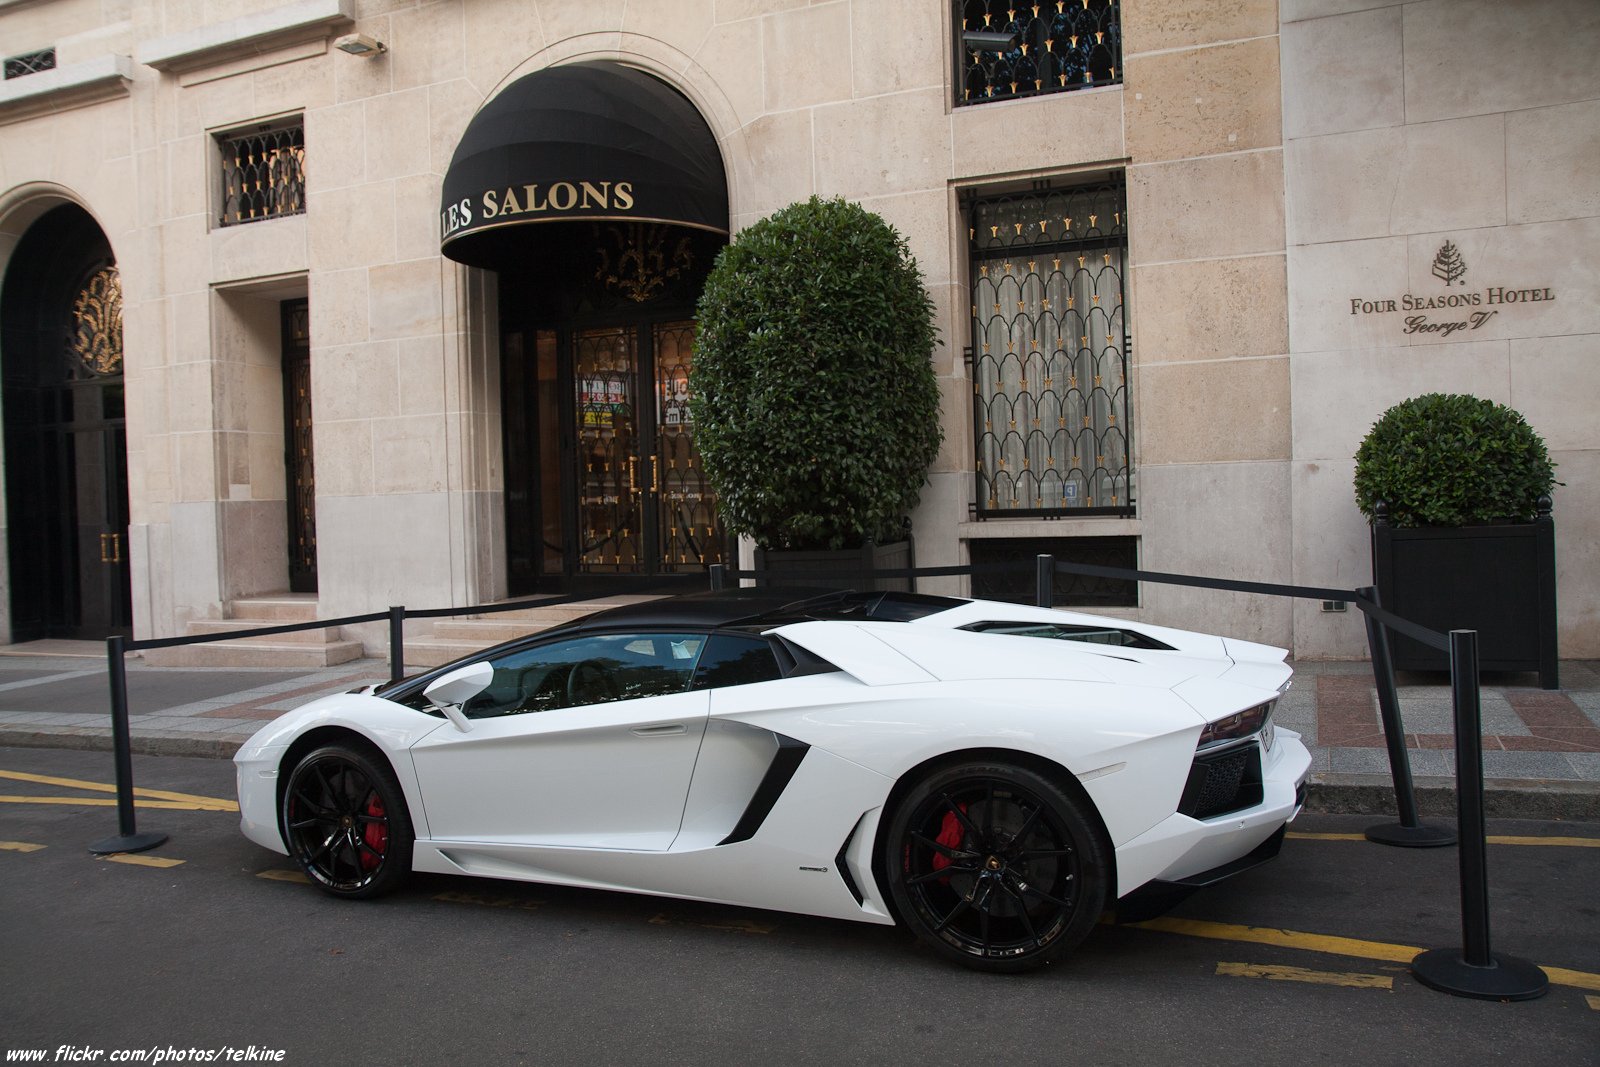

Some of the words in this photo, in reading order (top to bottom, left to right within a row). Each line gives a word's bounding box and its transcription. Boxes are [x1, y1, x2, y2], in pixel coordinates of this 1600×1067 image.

[441, 198, 472, 238] LES
[483, 181, 634, 219] SALONS
[1350, 298, 1397, 315] FOUR
[1402, 294, 1481, 311] SEASONS
[1486, 287, 1556, 305] HOTEL
[1402, 315, 1468, 337] George
[1469, 310, 1499, 330] V
